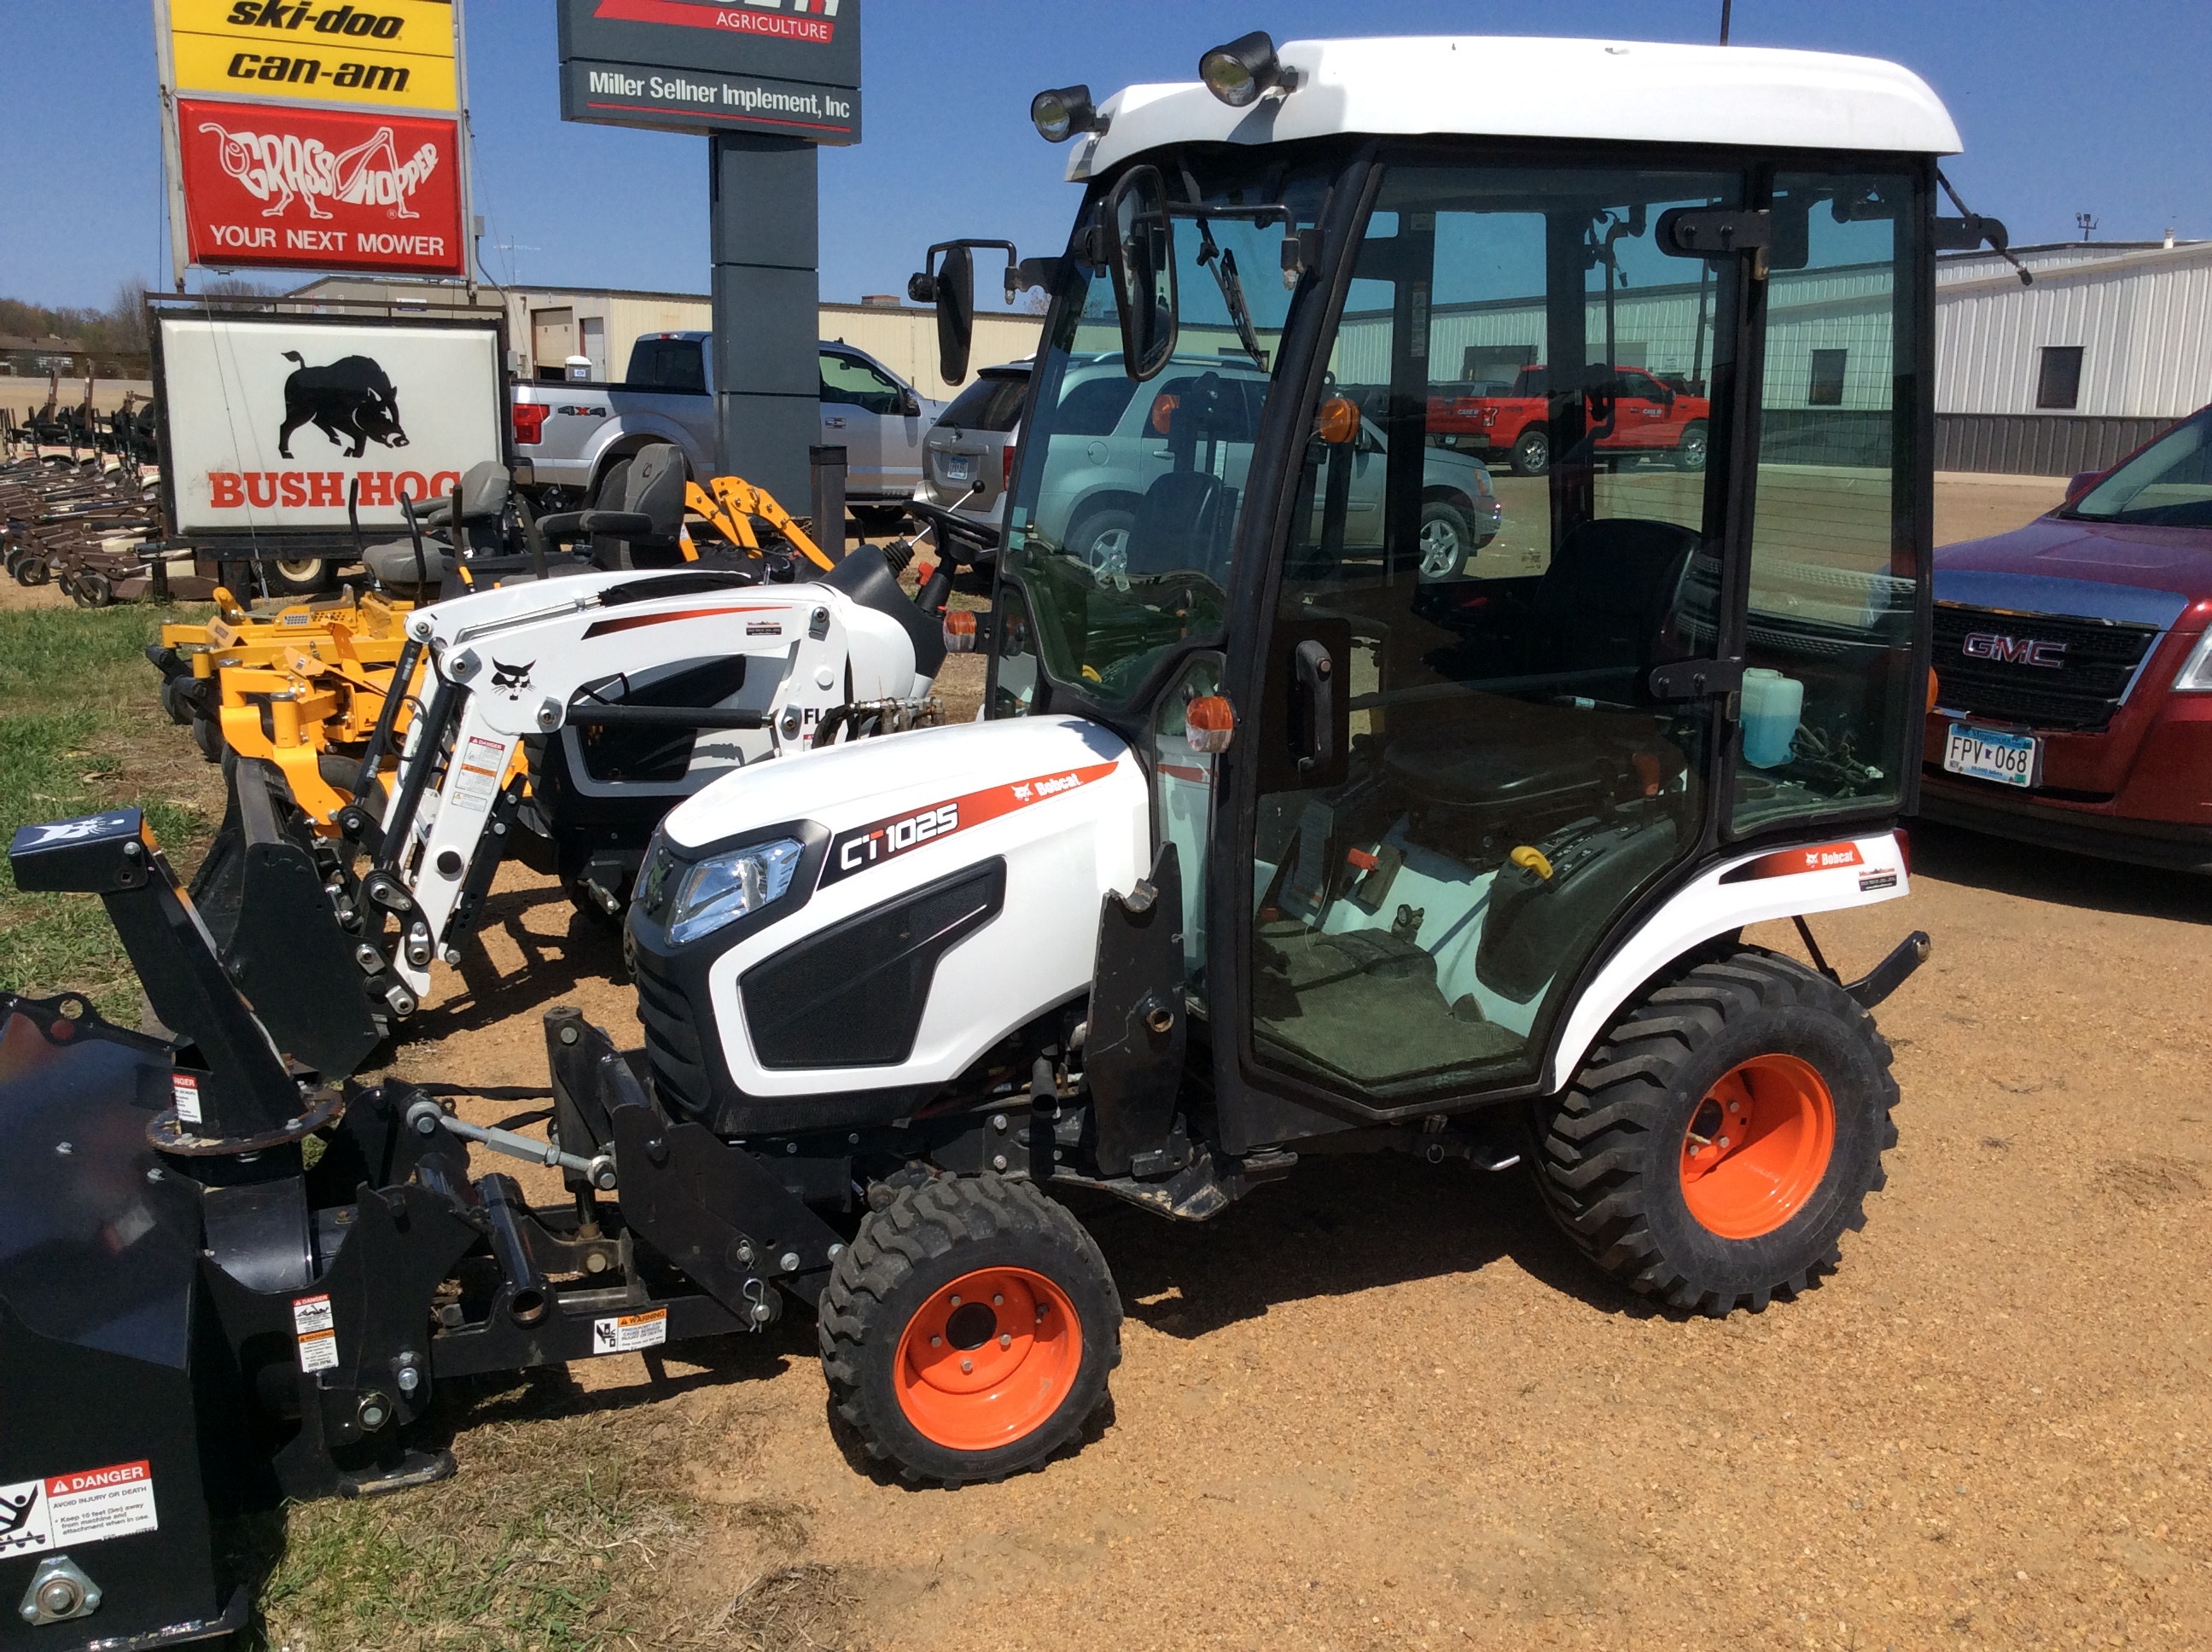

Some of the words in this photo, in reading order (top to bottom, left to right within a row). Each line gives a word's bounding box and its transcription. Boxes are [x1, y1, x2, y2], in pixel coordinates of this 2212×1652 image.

[227, 0, 405, 39] ski-doo
[716, 11, 828, 40] AGRICULTURE
[227, 52, 410, 92] can-am
[589, 71, 645, 96] Miller
[649, 75, 718, 103] Sellner
[723, 84, 822, 119] Implement,
[825, 96, 851, 119] Inc
[209, 224, 277, 249] YOUR
[287, 229, 348, 252] NEXT
[358, 232, 445, 257] MOWER
[208, 470, 346, 509] BUSH
[1963, 632, 2067, 668] GMC
[1950, 736, 1983, 764] FPV
[1994, 745, 2028, 773] 068
[1033, 772, 1081, 797] Bobcat
[841, 802, 959, 871] CT1025
[1821, 850, 1854, 866] Bobcat
[629, 1310, 665, 1323] WARNING
[72, 1466, 144, 1490] DANGER
[53, 1499, 78, 1509] AVOID
[79, 1494, 107, 1504] INJURY
[121, 1486, 147, 1496] DEATH
[60, 1515, 80, 1524] Keep
[125, 1503, 144, 1511] away
[61, 1521, 79, 1529] from
[80, 1515, 112, 1526] machine
[62, 1522, 104, 1535] attachment
[105, 1519, 125, 1527] when
